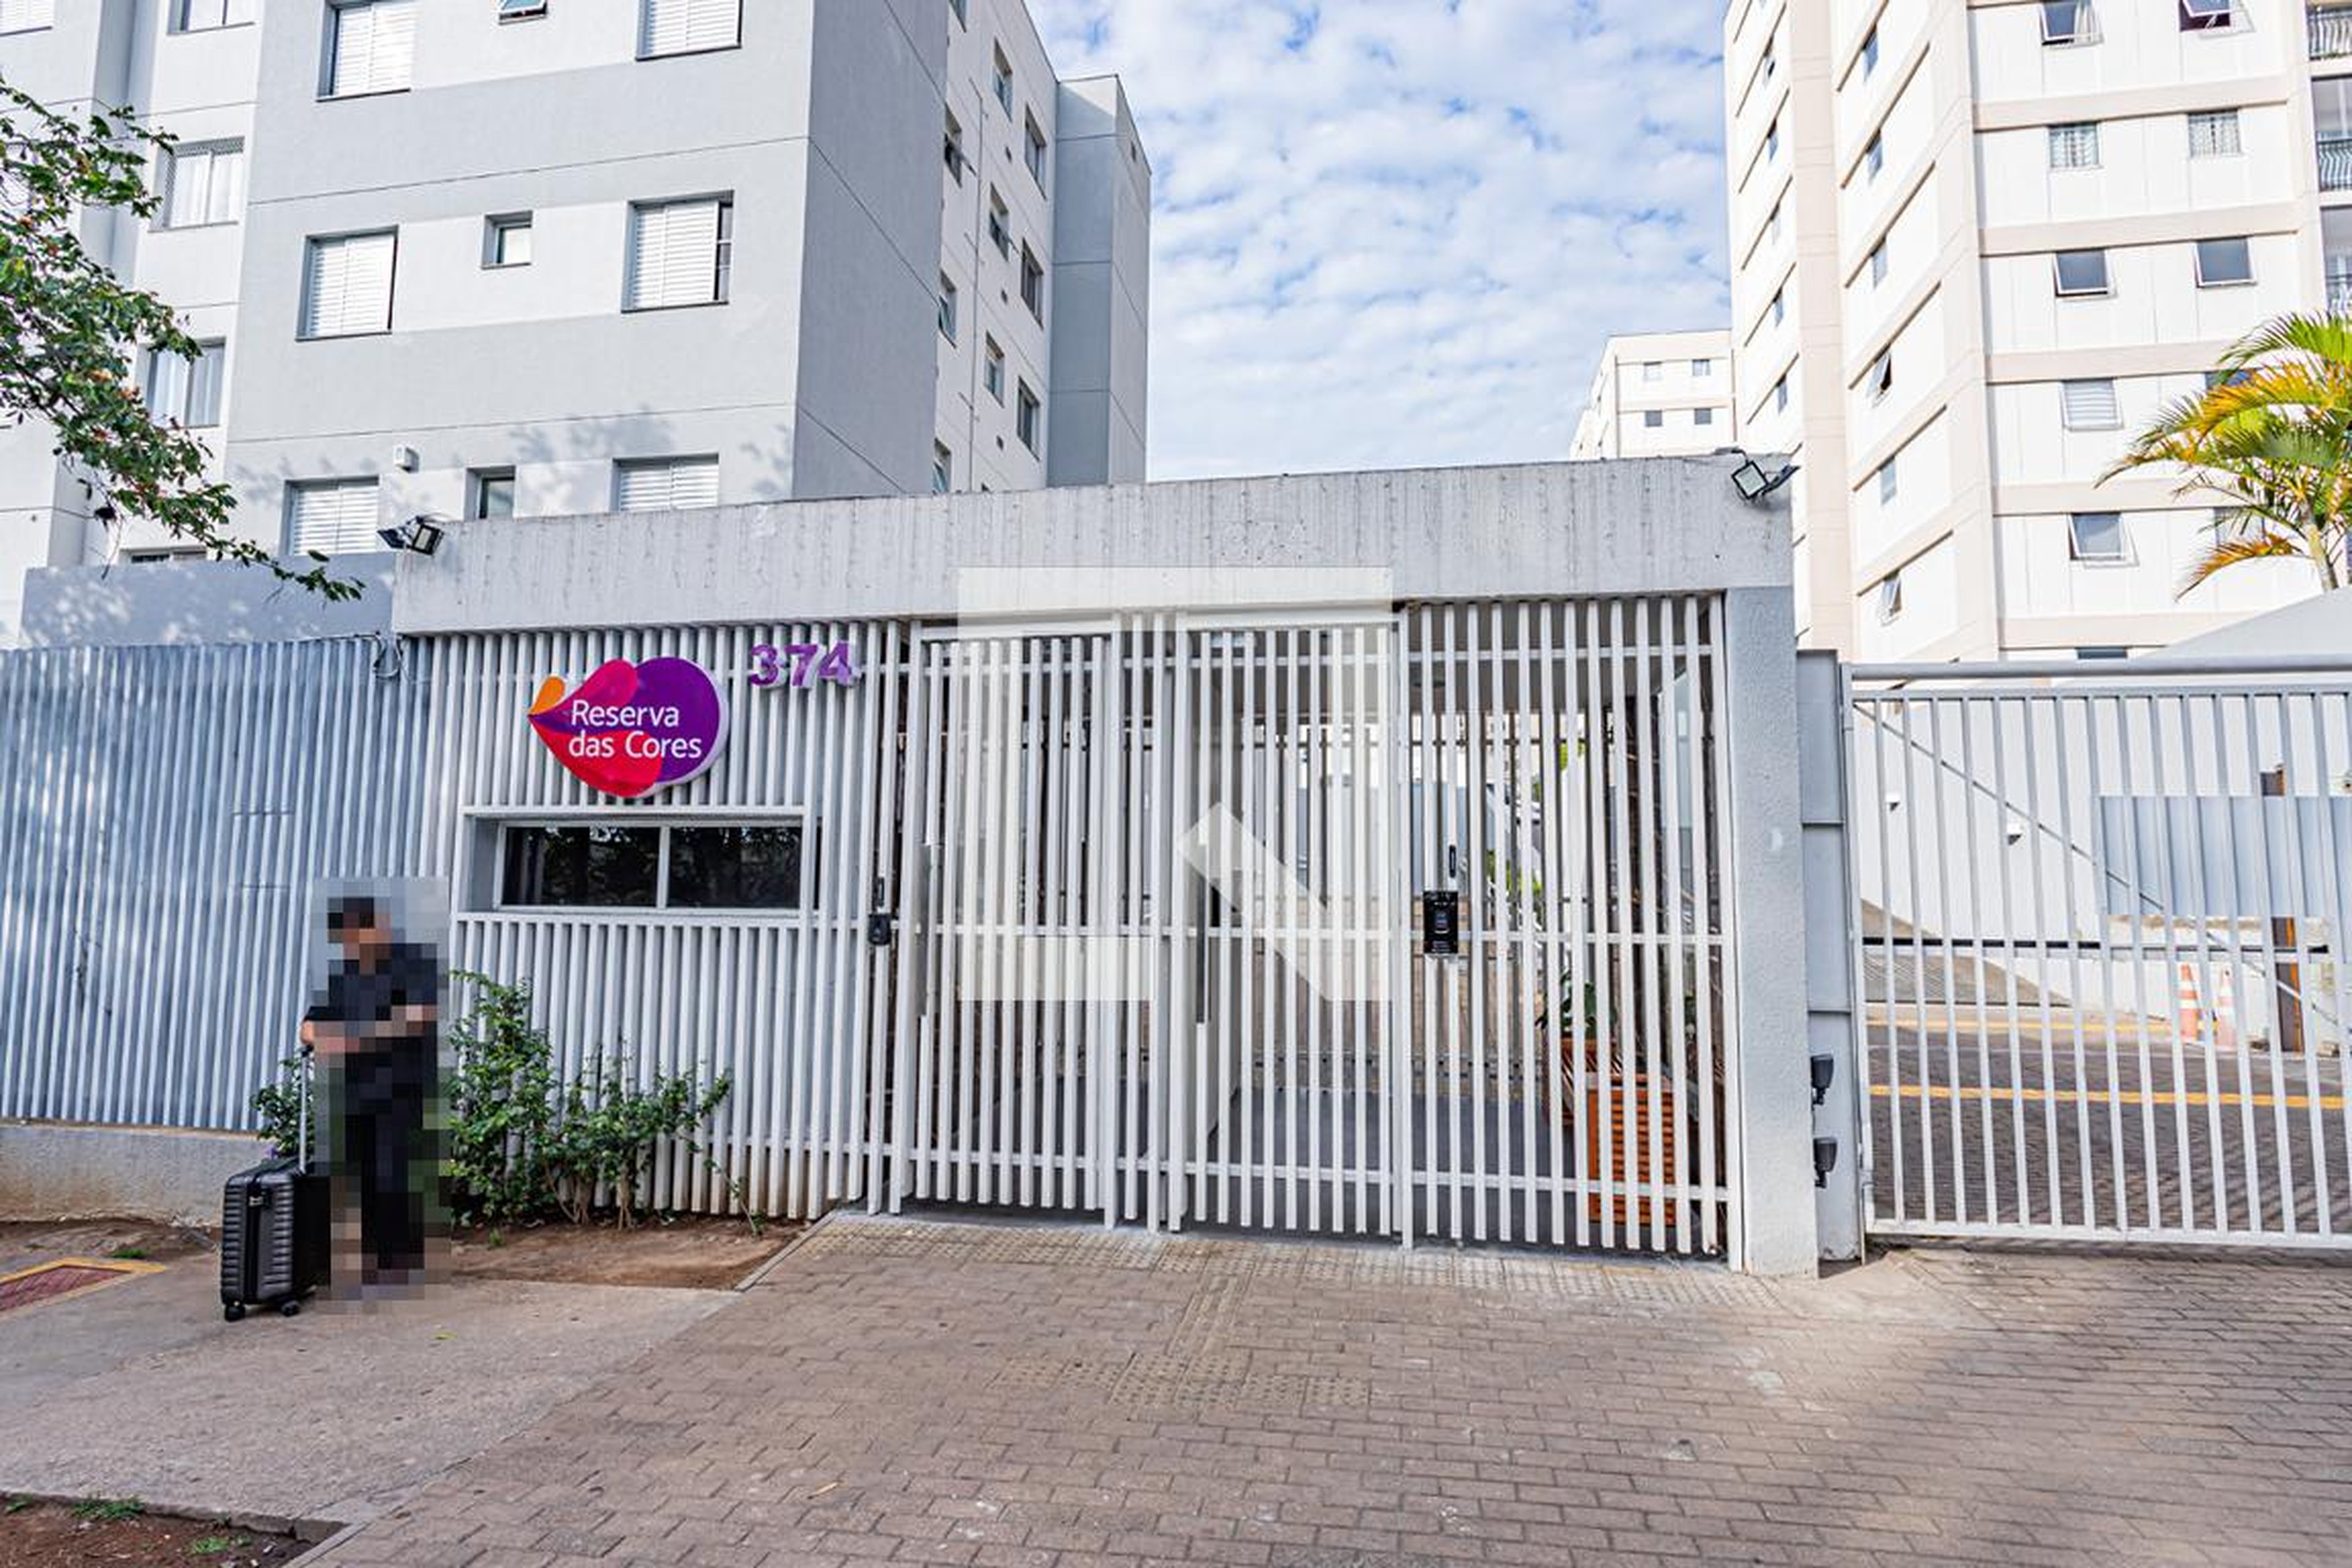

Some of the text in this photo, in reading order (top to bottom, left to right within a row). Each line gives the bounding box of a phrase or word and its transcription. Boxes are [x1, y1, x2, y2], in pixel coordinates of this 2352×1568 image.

[750, 640, 851, 686] 374
[571, 699, 679, 727] Reserva
[568, 729, 702, 758] das Cores
